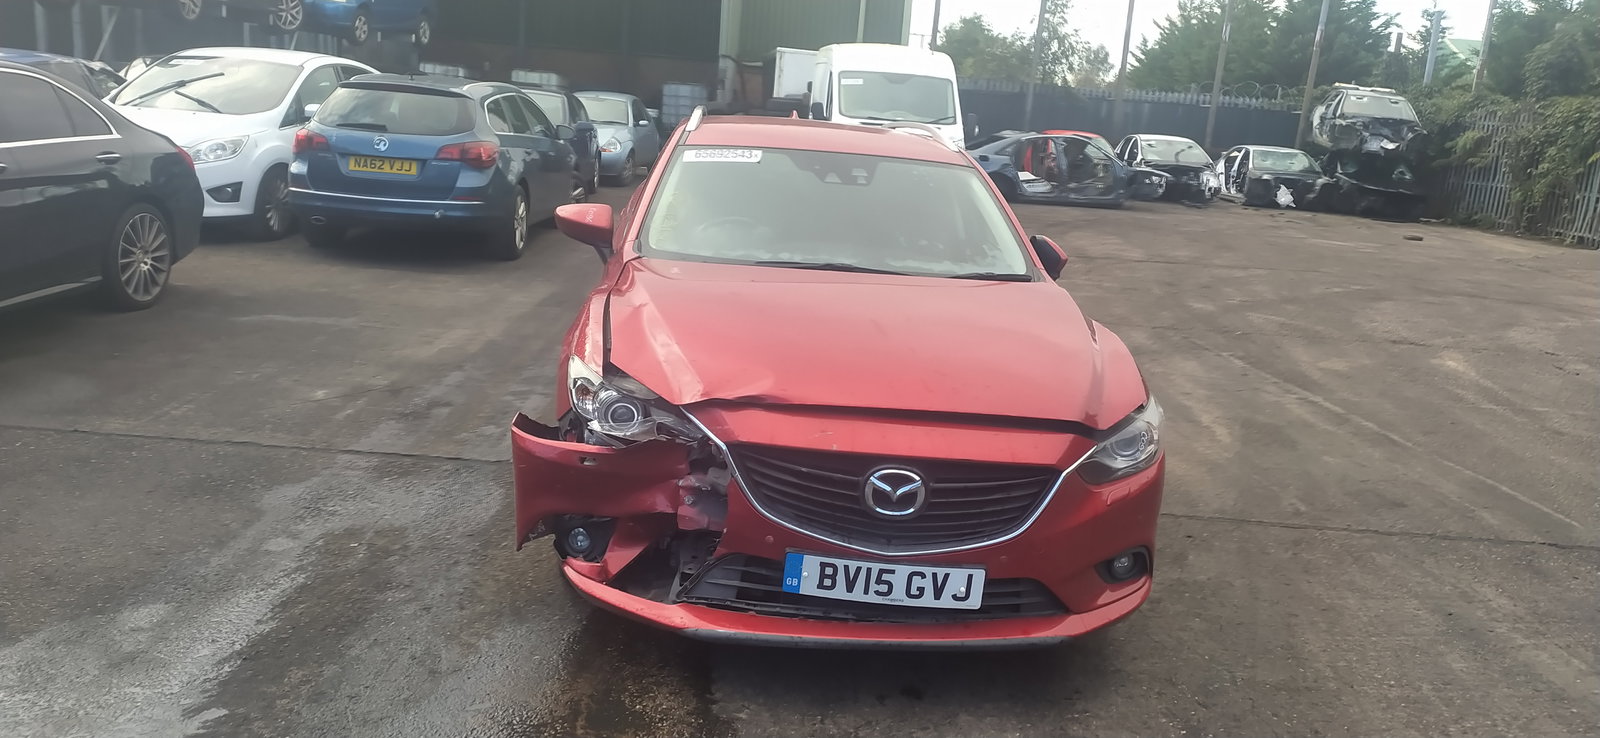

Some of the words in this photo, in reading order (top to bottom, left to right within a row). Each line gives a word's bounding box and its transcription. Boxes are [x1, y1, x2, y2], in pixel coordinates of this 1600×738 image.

[353, 158, 385, 170] NA62
[389, 160, 412, 172] VJJ
[786, 577, 798, 586] GB
[816, 561, 896, 597] BV15
[905, 570, 974, 602] GVJ
